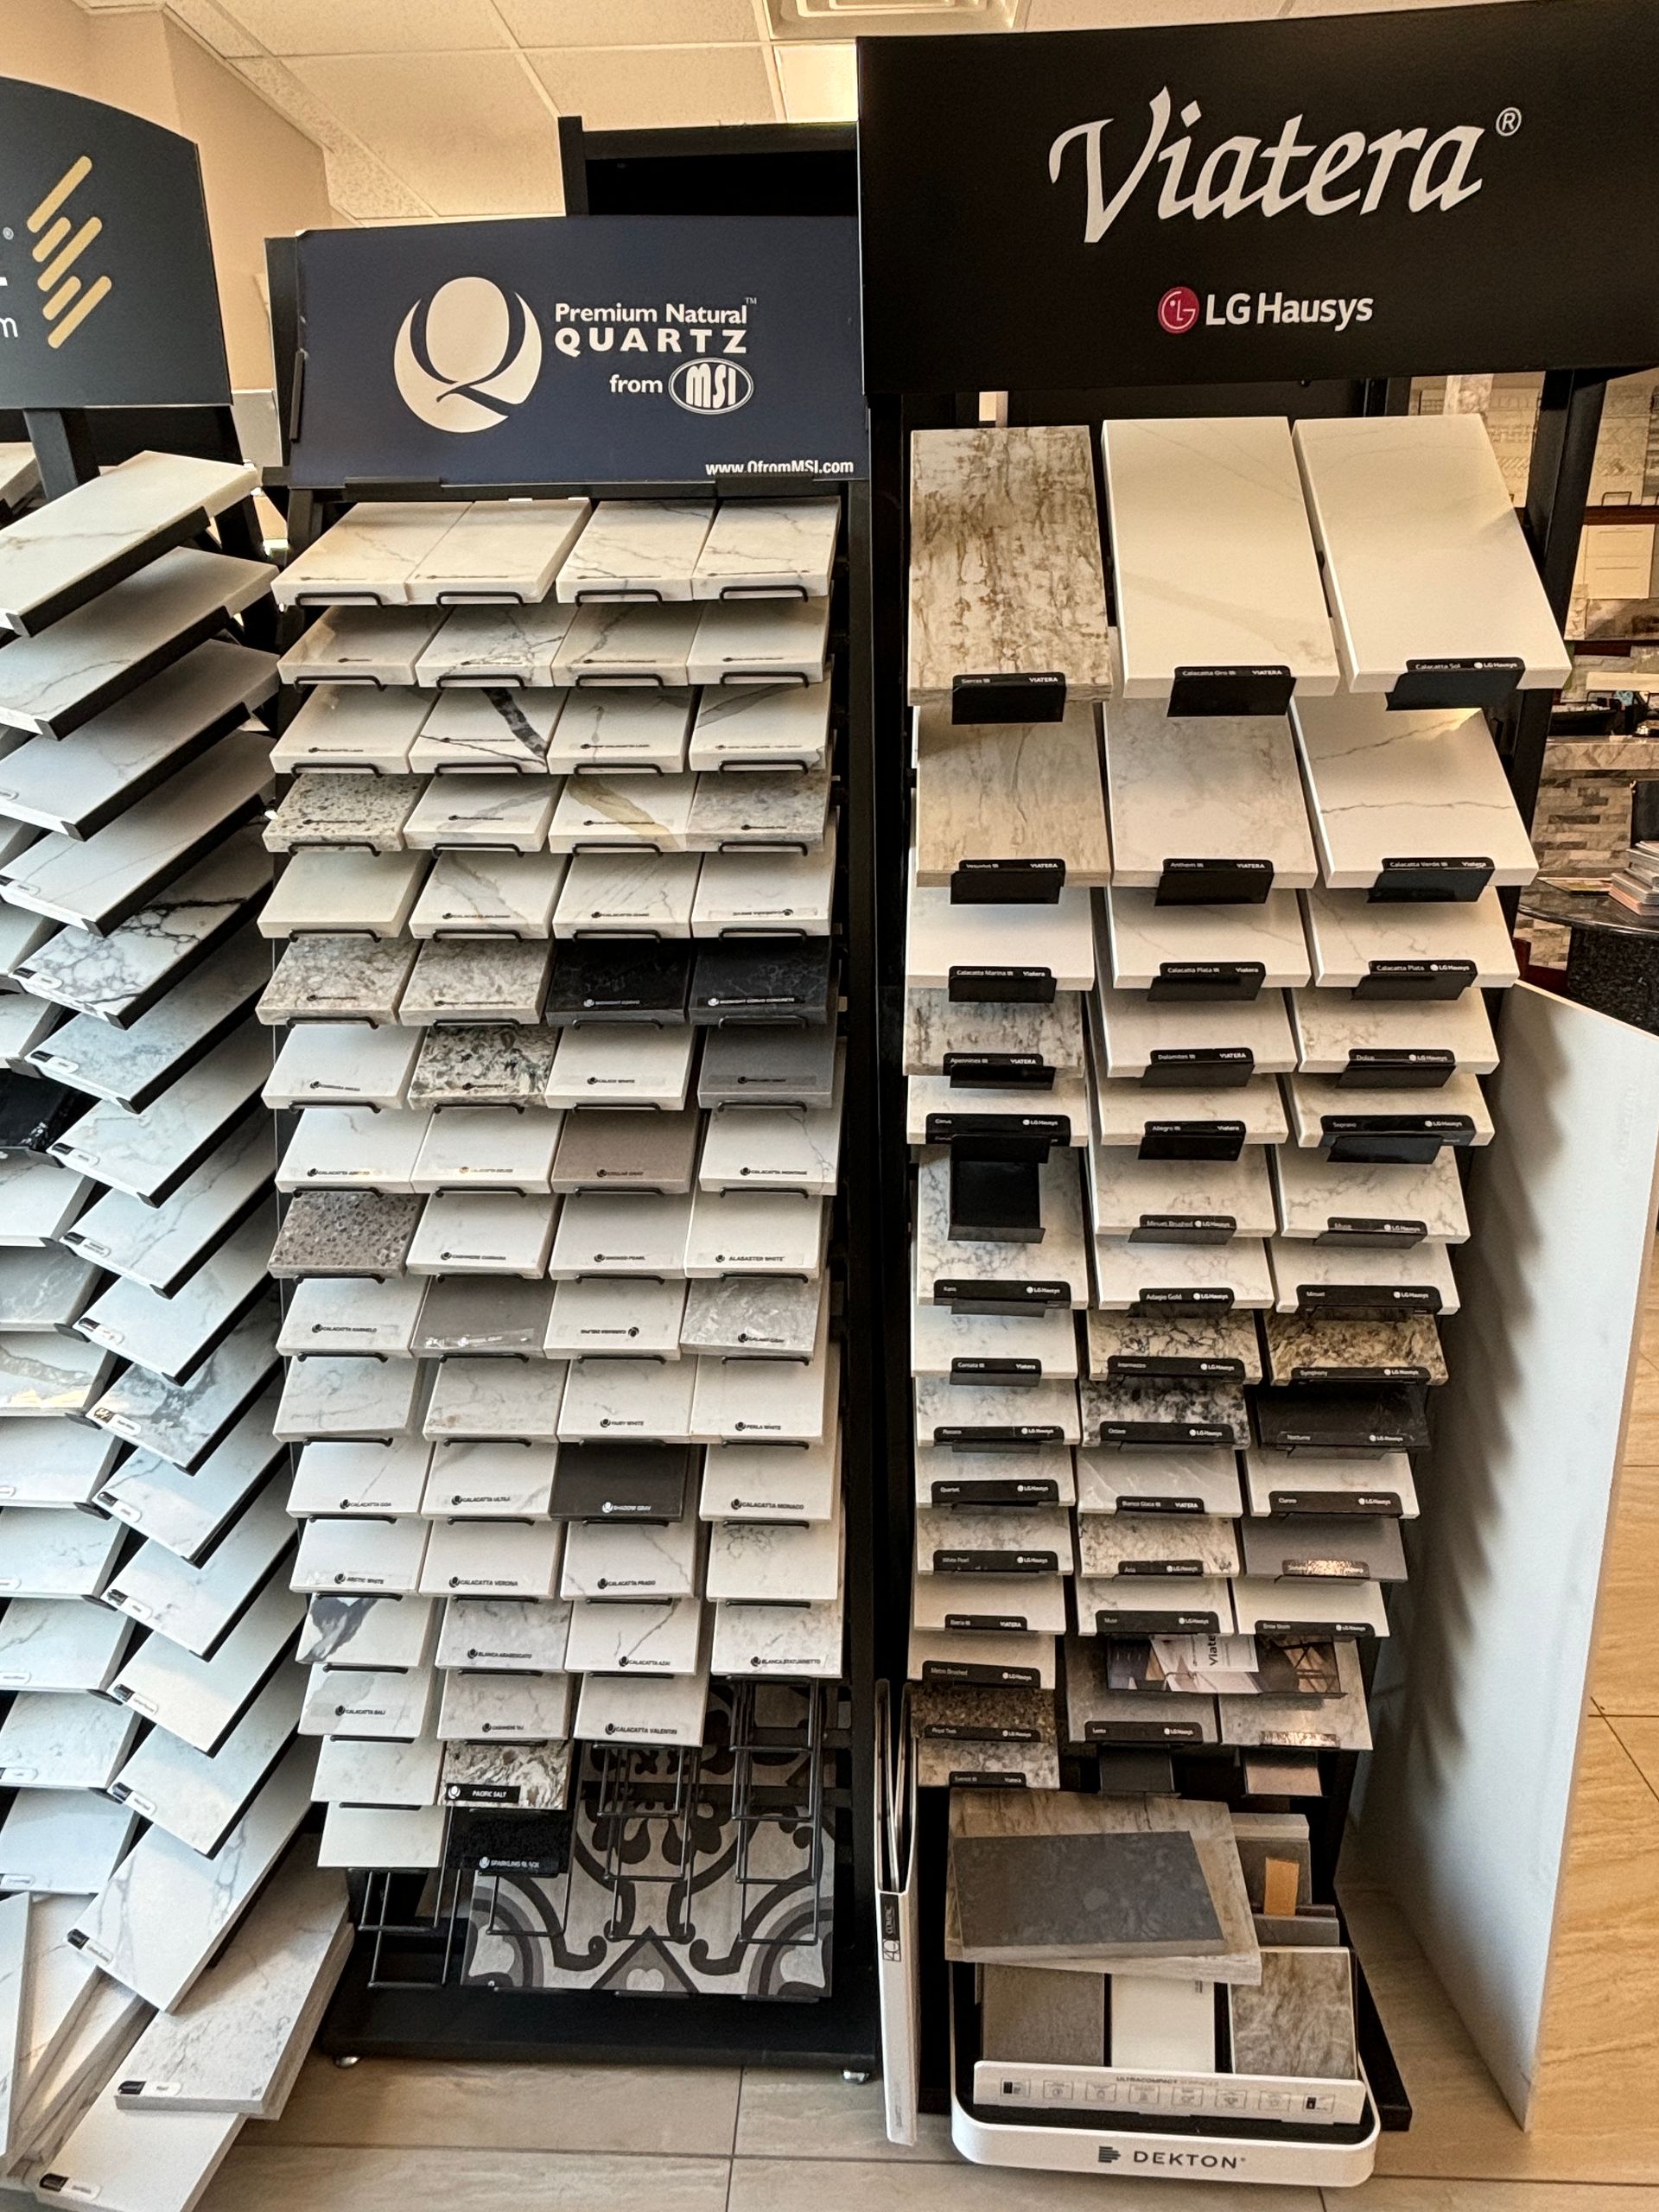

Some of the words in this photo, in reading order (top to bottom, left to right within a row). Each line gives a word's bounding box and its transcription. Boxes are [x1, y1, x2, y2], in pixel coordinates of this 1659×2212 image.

[556, 303, 657, 322] Premium
[1205, 293, 1251, 325] LG
[1256, 292, 1374, 332] Hausys
[555, 327, 747, 357] QUARTZ
[610, 374, 663, 393] from
[686, 363, 736, 409] MSI
